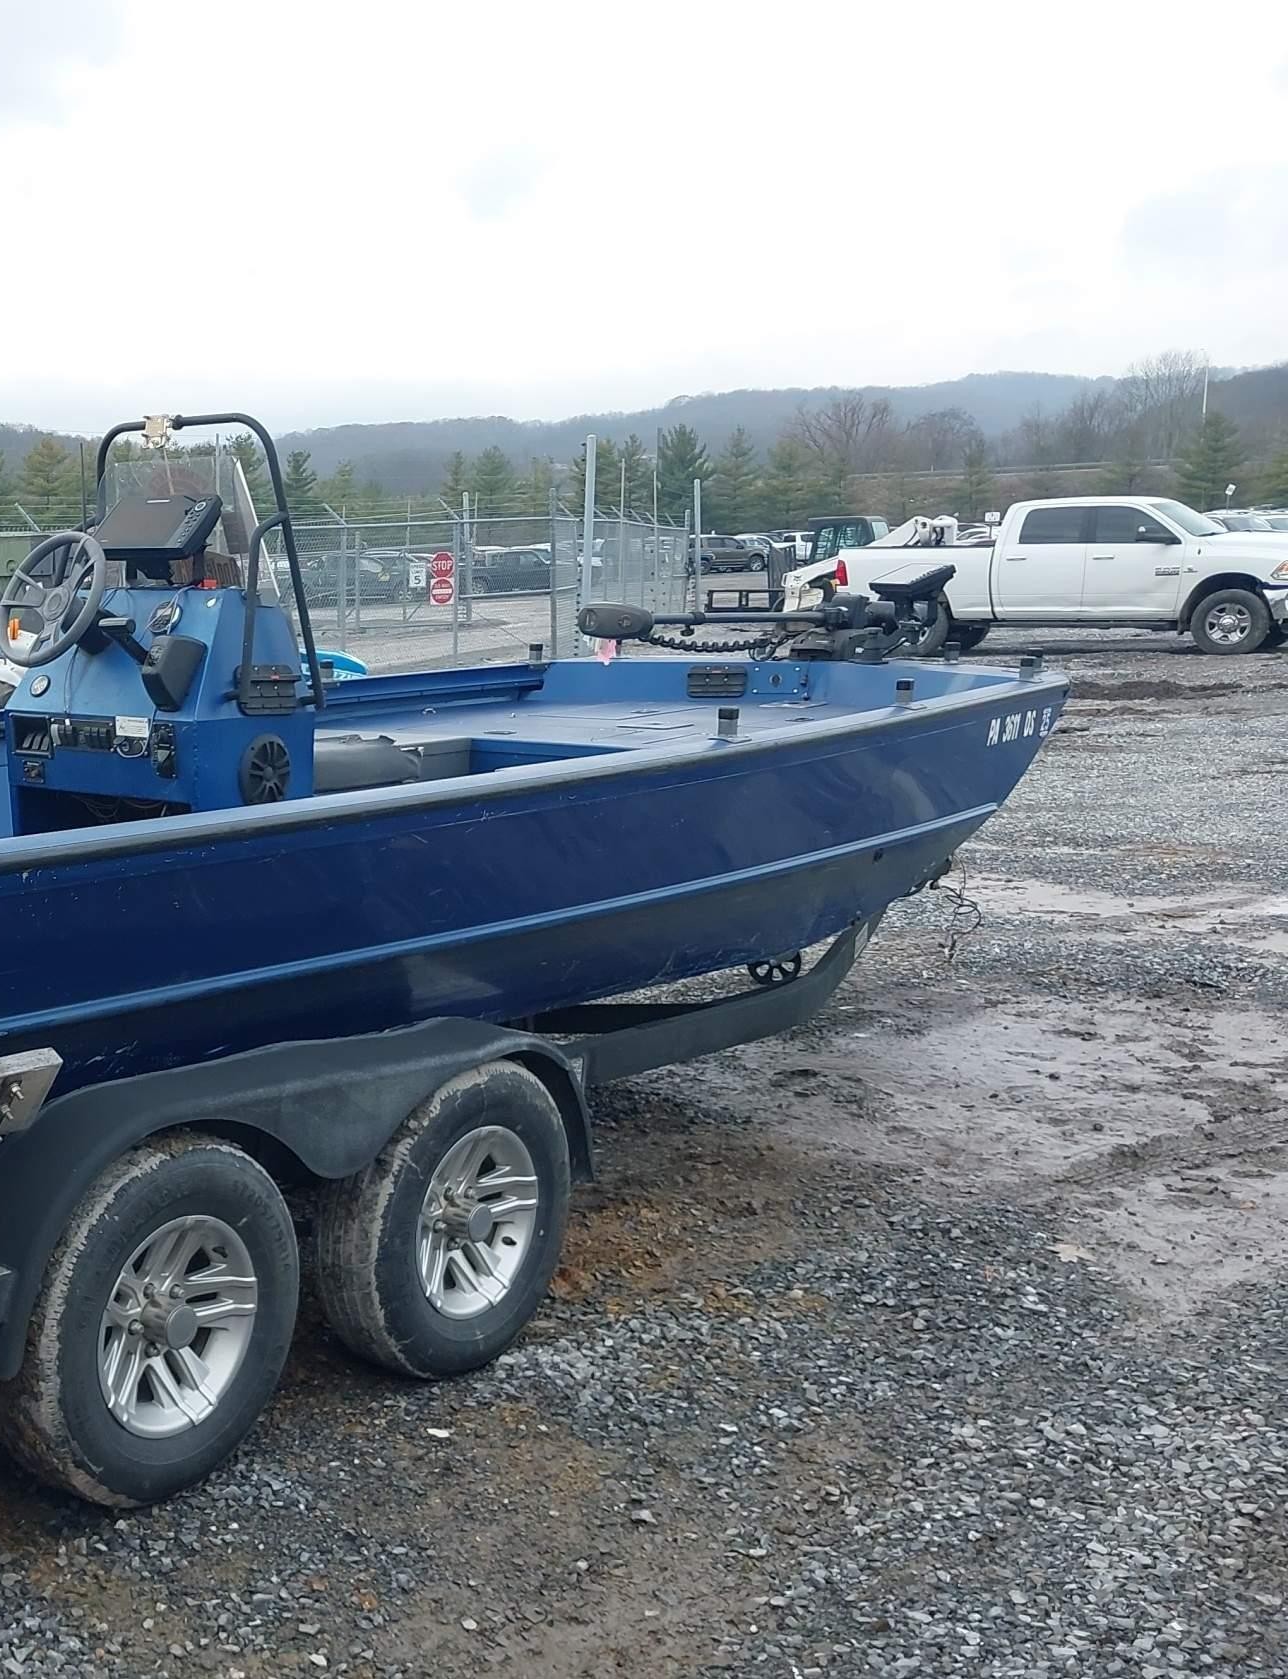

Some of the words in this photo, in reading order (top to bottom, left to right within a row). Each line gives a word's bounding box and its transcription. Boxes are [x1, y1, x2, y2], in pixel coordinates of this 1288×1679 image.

[432, 560, 453, 571] STOP
[413, 575, 422, 585] 5
[986, 717, 1001, 747] PA
